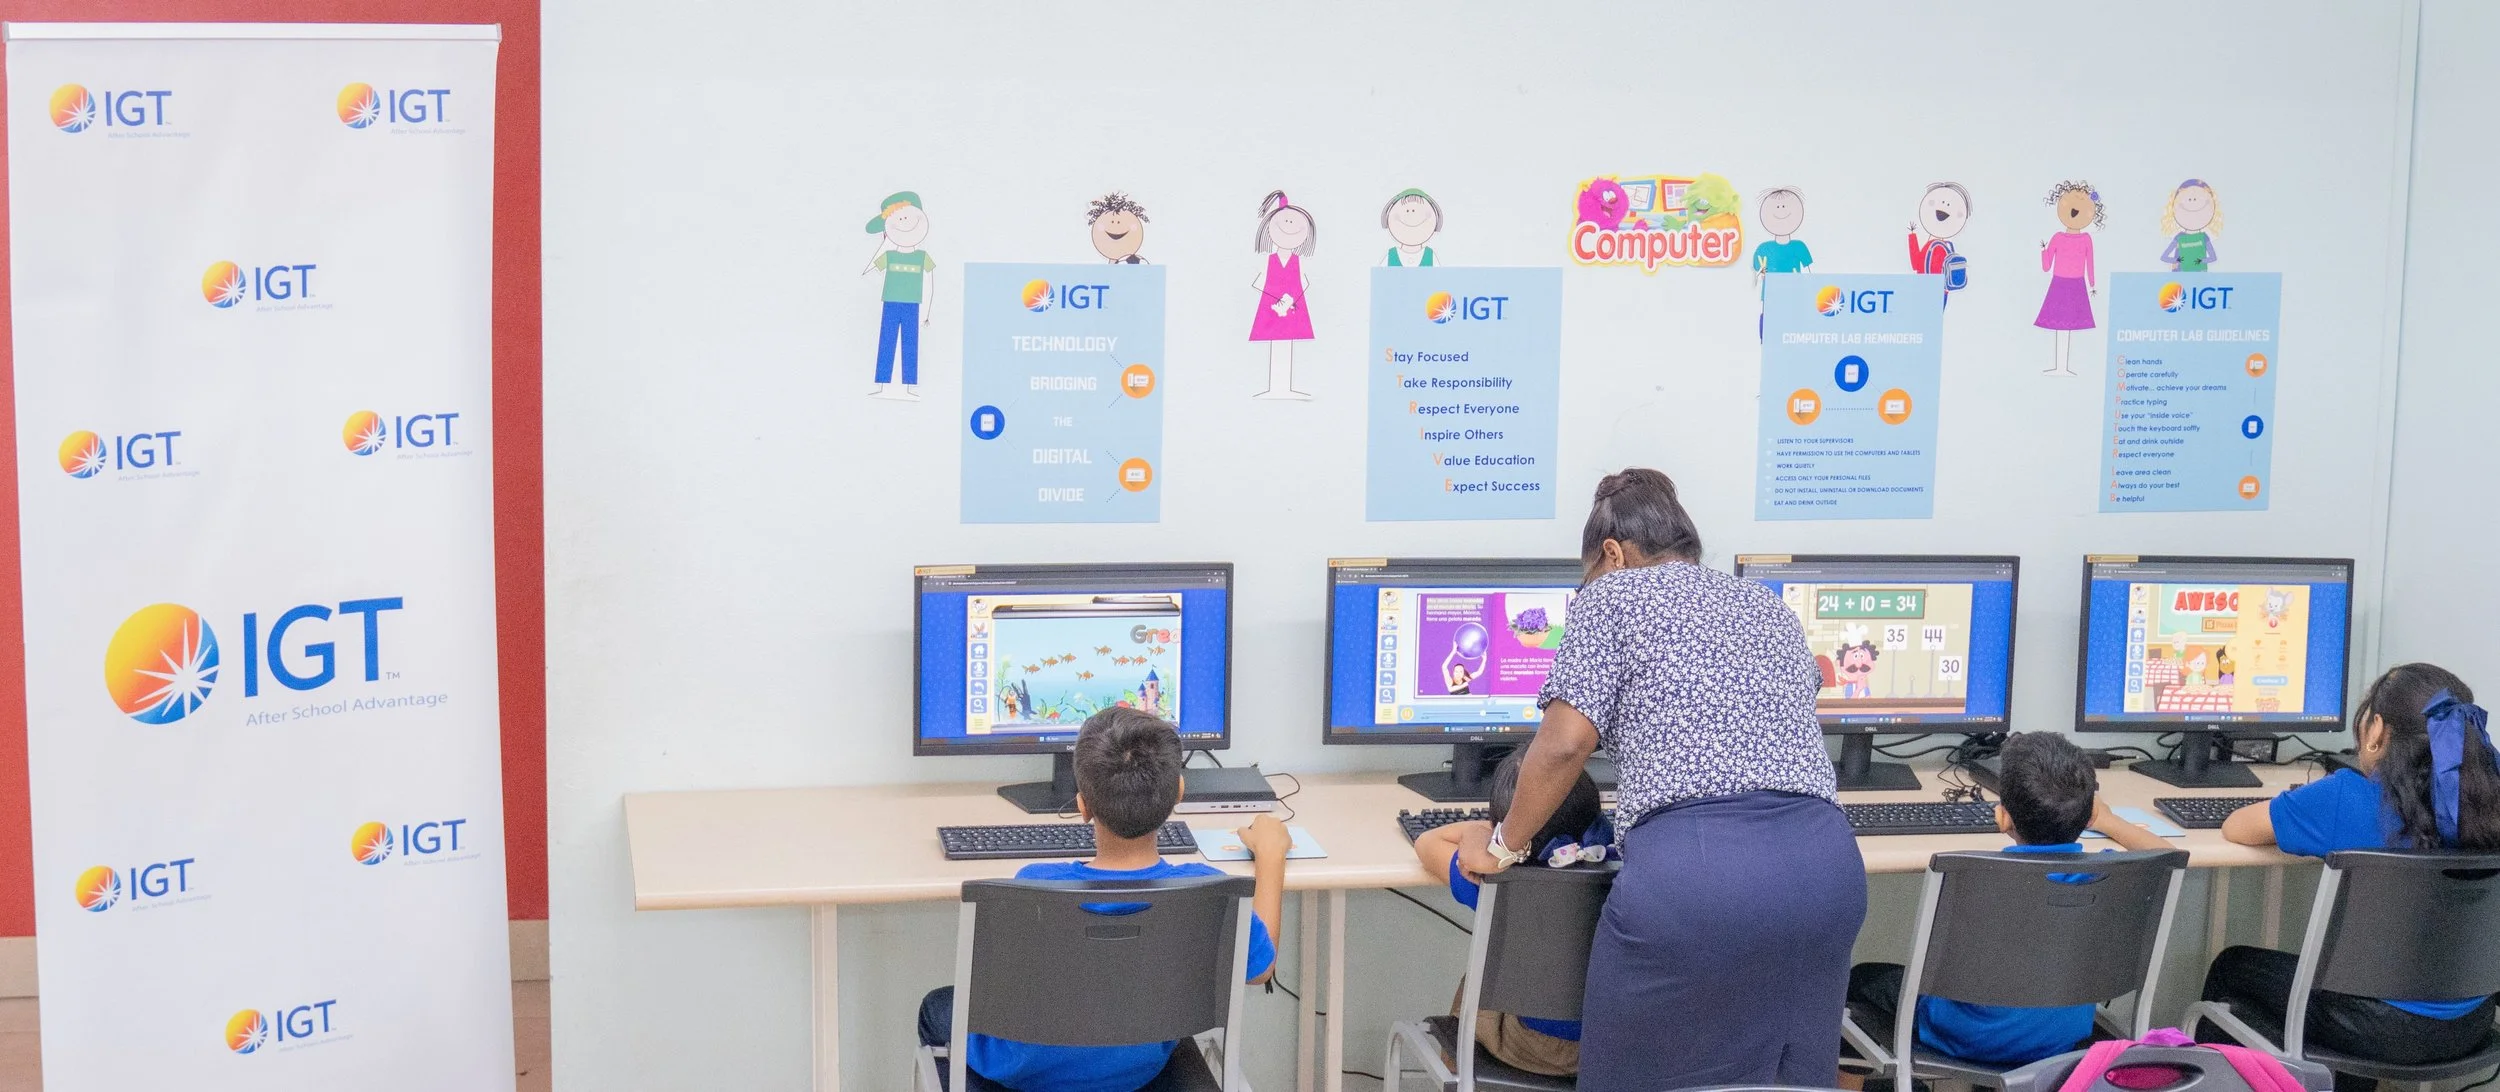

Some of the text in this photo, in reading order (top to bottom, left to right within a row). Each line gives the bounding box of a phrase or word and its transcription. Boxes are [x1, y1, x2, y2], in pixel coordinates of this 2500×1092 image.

[105, 90, 172, 126] IGT
[389, 89, 450, 124] IGT
[1574, 224, 1736, 269] Computer
[255, 264, 316, 300] IGT
[1061, 285, 1109, 309] IGT
[1850, 291, 1894, 314] IGT
[2191, 287, 2233, 310] IGT
[1462, 297, 1508, 320] IGT
[1782, 333, 1923, 344] COMPUTER LAB REMINDERS
[2117, 329, 2270, 342] COMPUTER LAB GUIDELINES
[1012, 336, 1118, 352] TECHNOLOGY
[1385, 348, 1469, 364] Stay Focused
[2117, 355, 2140, 365] Clean
[2117, 368, 2179, 379] Operate carefully
[1030, 376, 1097, 391] BRIDGING
[1396, 375, 1512, 390] Take Responsibility
[2115, 396, 2145, 405] Practice
[1409, 401, 1520, 416] Respect Everyone
[2115, 410, 2129, 419] Use
[1053, 416, 1073, 427] THE
[2113, 423, 2135, 432] Touch
[2183, 424, 2200, 432] softly
[395, 412, 459, 448] IGT
[1420, 428, 1504, 442] Inspire Others
[2113, 435, 2125, 445] Eat
[116, 431, 181, 470] IGT
[1033, 449, 1092, 464] DIGITAL
[2113, 448, 2141, 458] Respect
[1432, 453, 1535, 466] Value Education
[2112, 466, 2133, 476] Leave
[1445, 479, 1540, 494] Expect Success
[2111, 480, 2137, 490] Always
[1038, 488, 1084, 502] DIVIDE
[2110, 494, 2121, 502] Be
[1818, 595, 1916, 612] 24 + 10 = 34
[1887, 628, 1905, 643] 35
[1924, 628, 1943, 643] 44
[243, 596, 403, 698] IGT
[1941, 659, 1960, 673] 30
[246, 692, 448, 727] After School Advantage
[402, 818, 467, 856] IGT
[130, 858, 195, 900] IGT
[276, 999, 337, 1042] IGT
